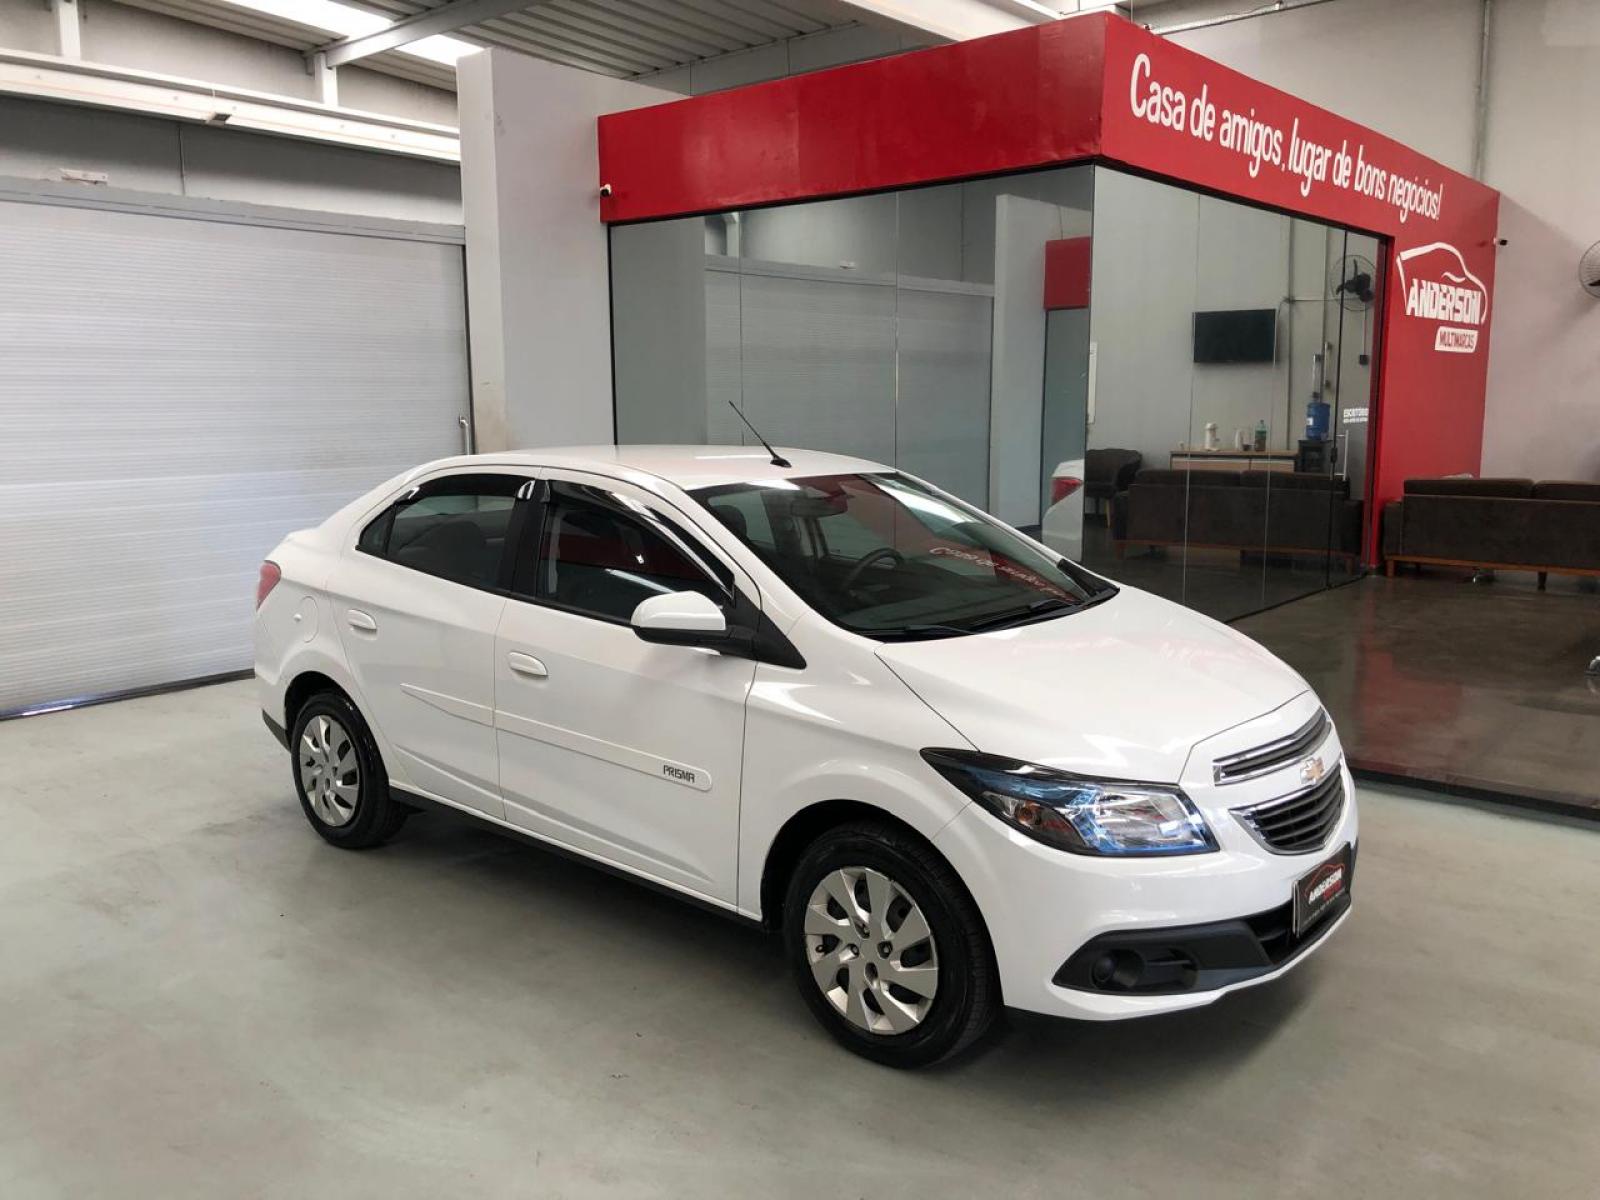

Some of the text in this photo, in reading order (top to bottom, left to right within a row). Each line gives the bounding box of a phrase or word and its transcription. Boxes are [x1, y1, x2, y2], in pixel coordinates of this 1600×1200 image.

[1130, 53, 1186, 132] Casa
[1190, 83, 1216, 141] de
[1219, 108, 1285, 178] amigos,
[1288, 117, 1332, 197] lugar
[1333, 139, 1352, 189] de
[1354, 144, 1387, 200] bons
[1406, 278, 1481, 325] ANDERSON
[663, 764, 695, 784] PRISMA
